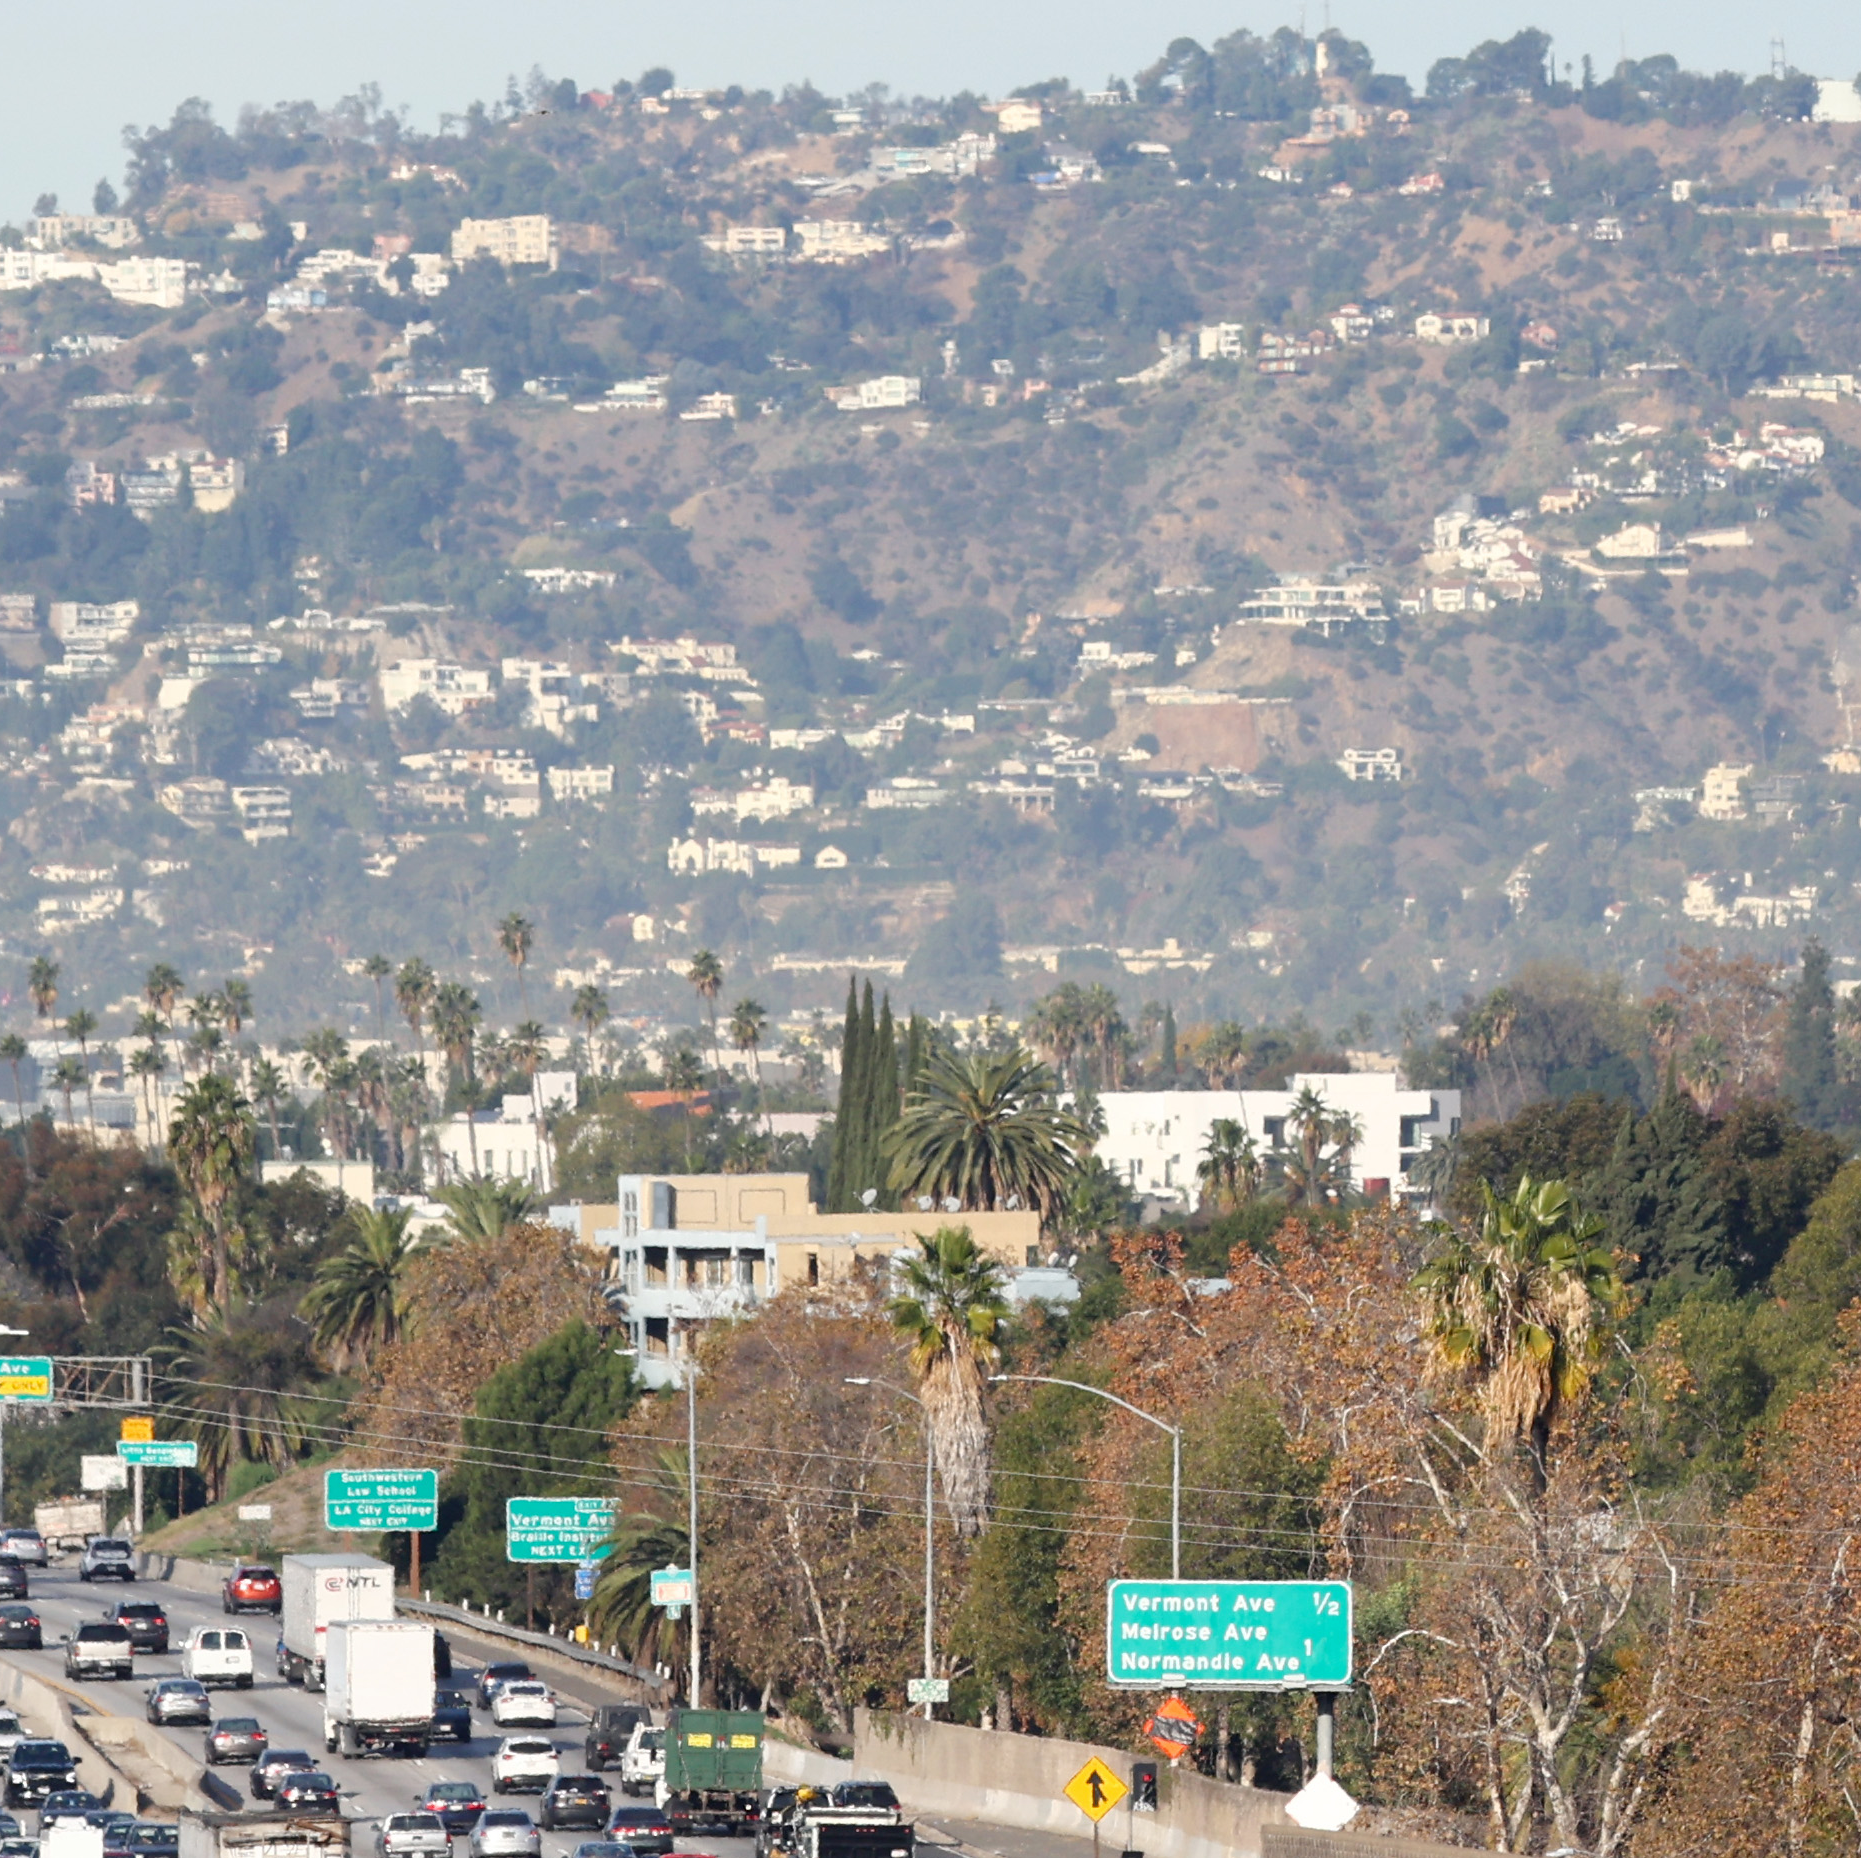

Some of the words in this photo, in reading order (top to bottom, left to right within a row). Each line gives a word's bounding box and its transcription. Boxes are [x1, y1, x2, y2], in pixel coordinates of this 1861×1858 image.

[0, 1362, 31, 1374] Ave
[11, 1380, 45, 1391] ONLY
[341, 1473, 423, 1483] Southwestern
[347, 1487, 371, 1497] Law
[376, 1485, 417, 1496] School
[334, 1505, 352, 1515] LA
[357, 1504, 382, 1516] City
[388, 1504, 432, 1516] College
[511, 1513, 580, 1526] Vermont
[530, 1545, 564, 1556] NEXT
[1122, 1593, 1219, 1613] Vermont
[1233, 1594, 1276, 1613] Ave
[1121, 1622, 1211, 1641] Melrose
[1224, 1622, 1268, 1641] Ave
[1304, 1638, 1313, 1656] 1
[1121, 1652, 1244, 1671] Normandie
[1256, 1653, 1300, 1671] Ave
